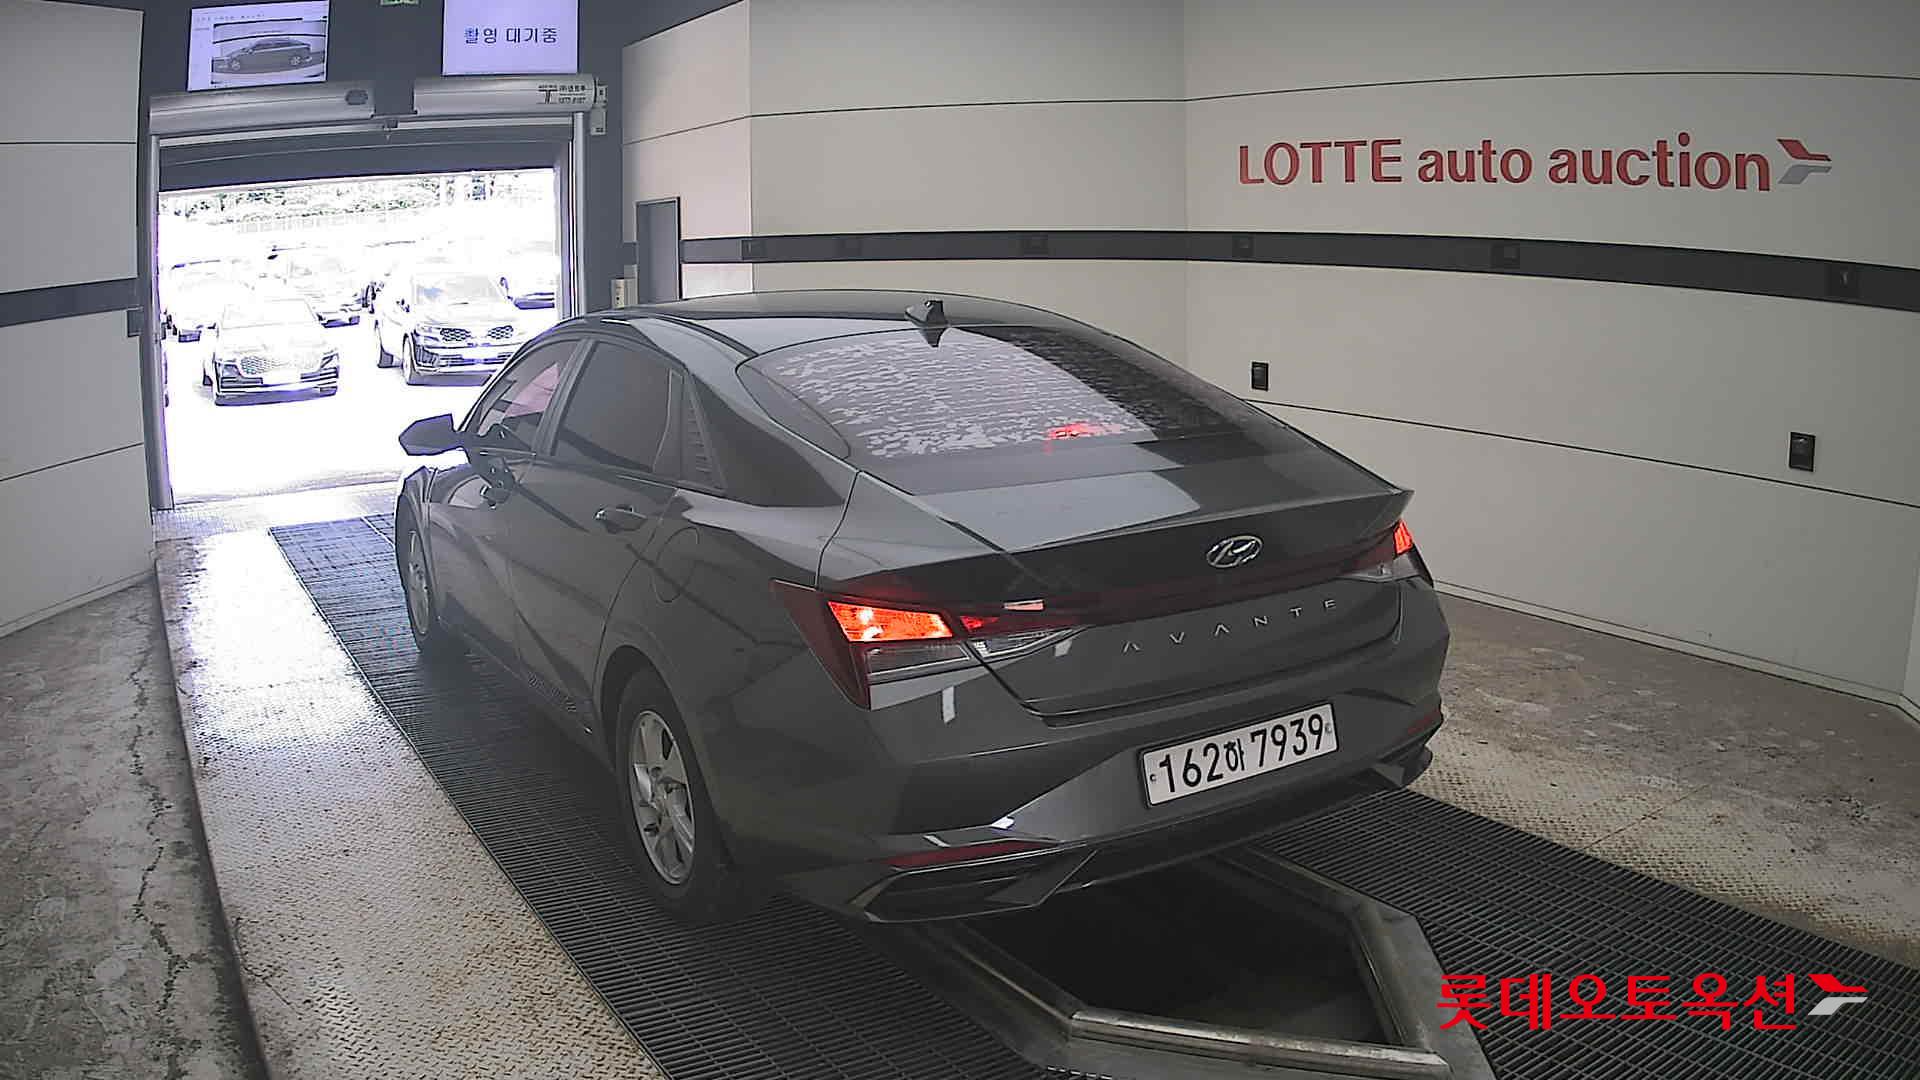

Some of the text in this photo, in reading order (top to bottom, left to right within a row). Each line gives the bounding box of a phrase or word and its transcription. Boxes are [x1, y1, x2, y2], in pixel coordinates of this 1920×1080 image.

[506, 28, 558, 43] 대기중
[1239, 132, 1771, 191] LOTTE auto auction
[1123, 599, 1337, 653] AVANTE
